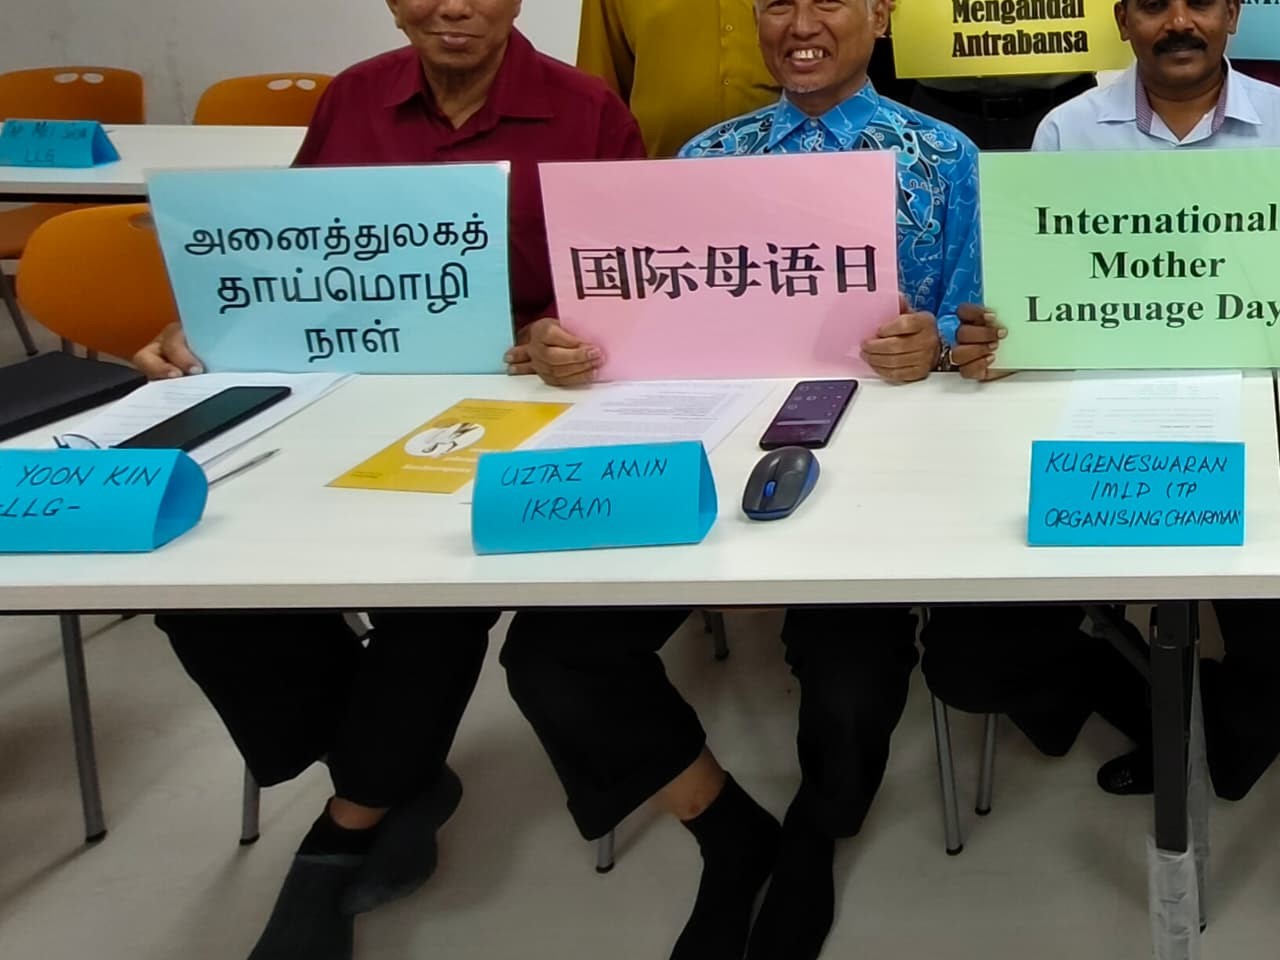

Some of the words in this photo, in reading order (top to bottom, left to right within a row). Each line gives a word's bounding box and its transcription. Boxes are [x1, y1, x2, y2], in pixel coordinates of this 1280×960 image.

[951, 29, 1089, 58] Antrabansa
[1034, 203, 1277, 235] International
[183, 212, 489, 261] அனைத்துலகத்
[569, 242, 877, 301] 国际母语日
[1090, 250, 1226, 279] Mother
[216, 261, 470, 315] தாய்மொழி
[1026, 295, 1204, 329] Language
[303, 318, 401, 364] நாள்
[15, 463, 95, 488] YOON
[102, 465, 162, 487] KIN
[500, 461, 584, 487] UZTAZ
[600, 457, 668, 481] AMIN
[1044, 451, 1228, 475] KUGENESWARAN
[521, 496, 612, 524] IKRAM
[1044, 507, 1162, 529] ORGANISING
